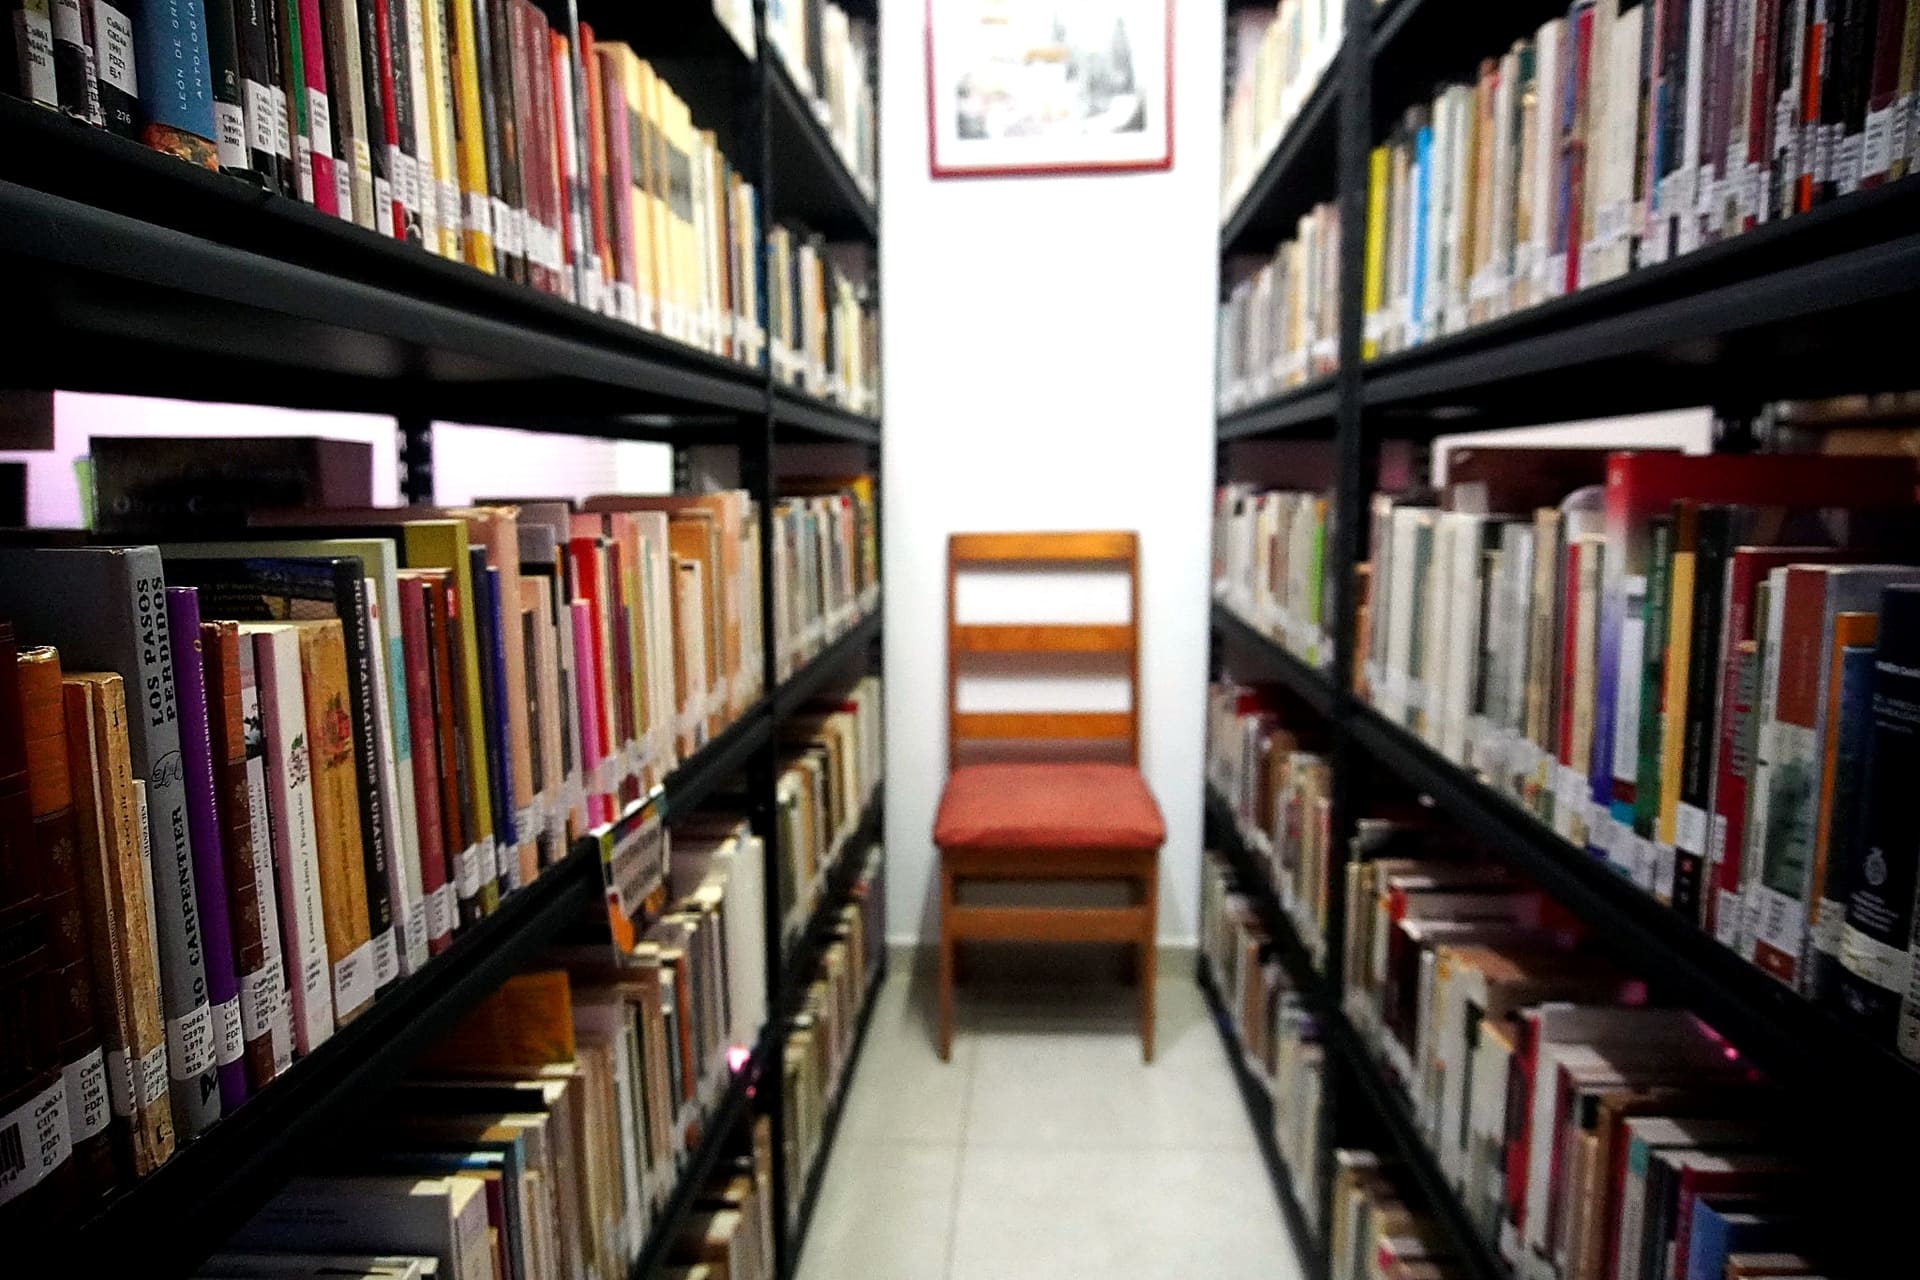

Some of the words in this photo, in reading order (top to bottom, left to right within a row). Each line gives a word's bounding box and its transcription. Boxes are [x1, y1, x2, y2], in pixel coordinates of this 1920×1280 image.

[173, 39, 182, 59] DE
[116, 109, 132, 125] 276
[177, 69, 187, 111] LEÓN
[136, 578, 157, 666] PASOS
[151, 576, 176, 722] PERDIDOS
[353, 579, 366, 650] NUEVOS
[147, 675, 165, 727] LOS
[359, 657, 377, 789] NARRADORES
[370, 790, 384, 874] CUBANOS
[172, 805, 200, 967] CARPENTIER
